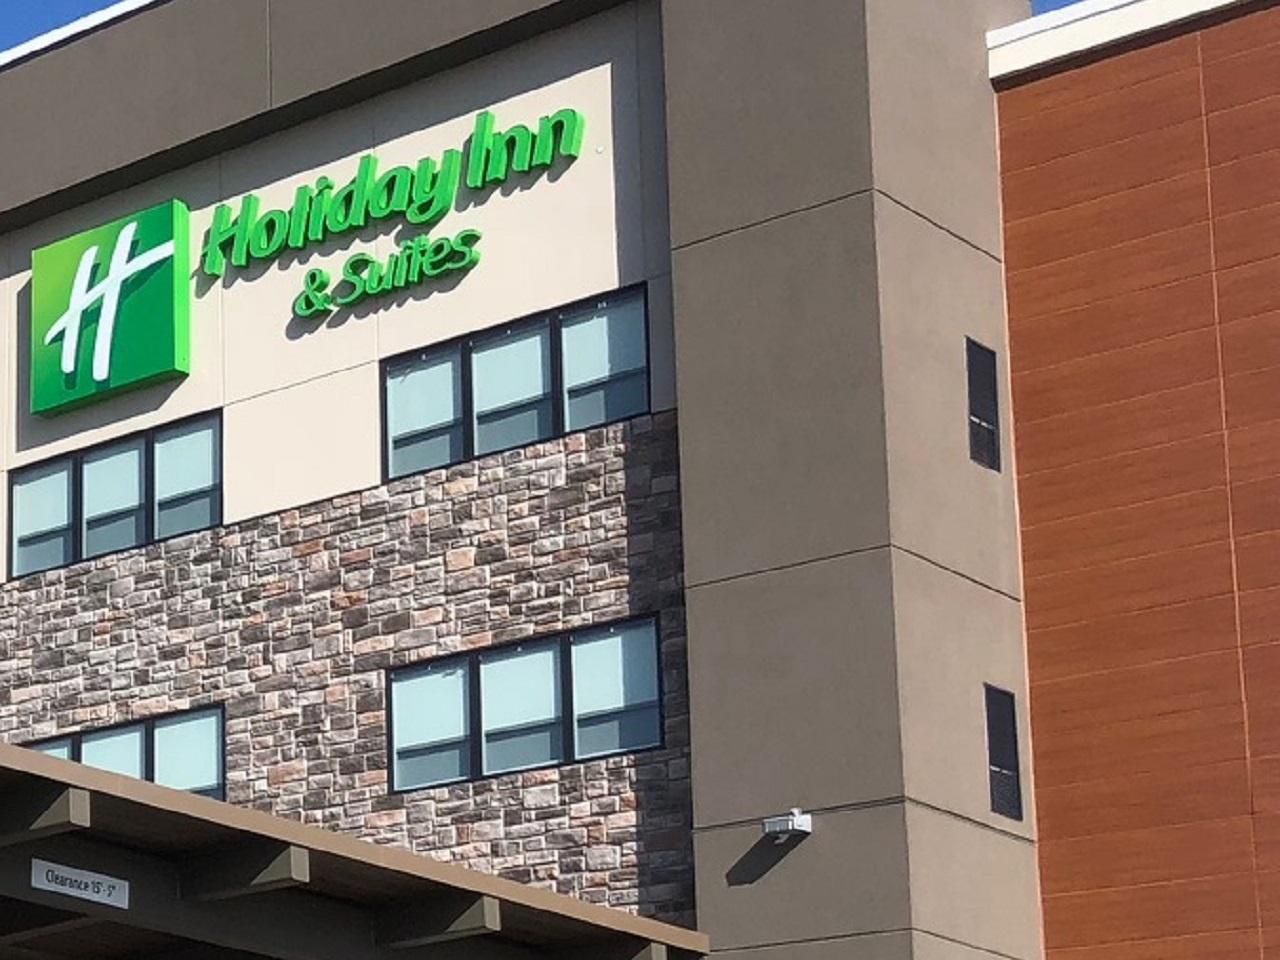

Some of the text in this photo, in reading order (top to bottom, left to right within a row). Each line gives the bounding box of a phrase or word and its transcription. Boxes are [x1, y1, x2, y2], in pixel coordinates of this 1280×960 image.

[291, 228, 482, 318] & Suites
[45, 869, 90, 892] Clearance
